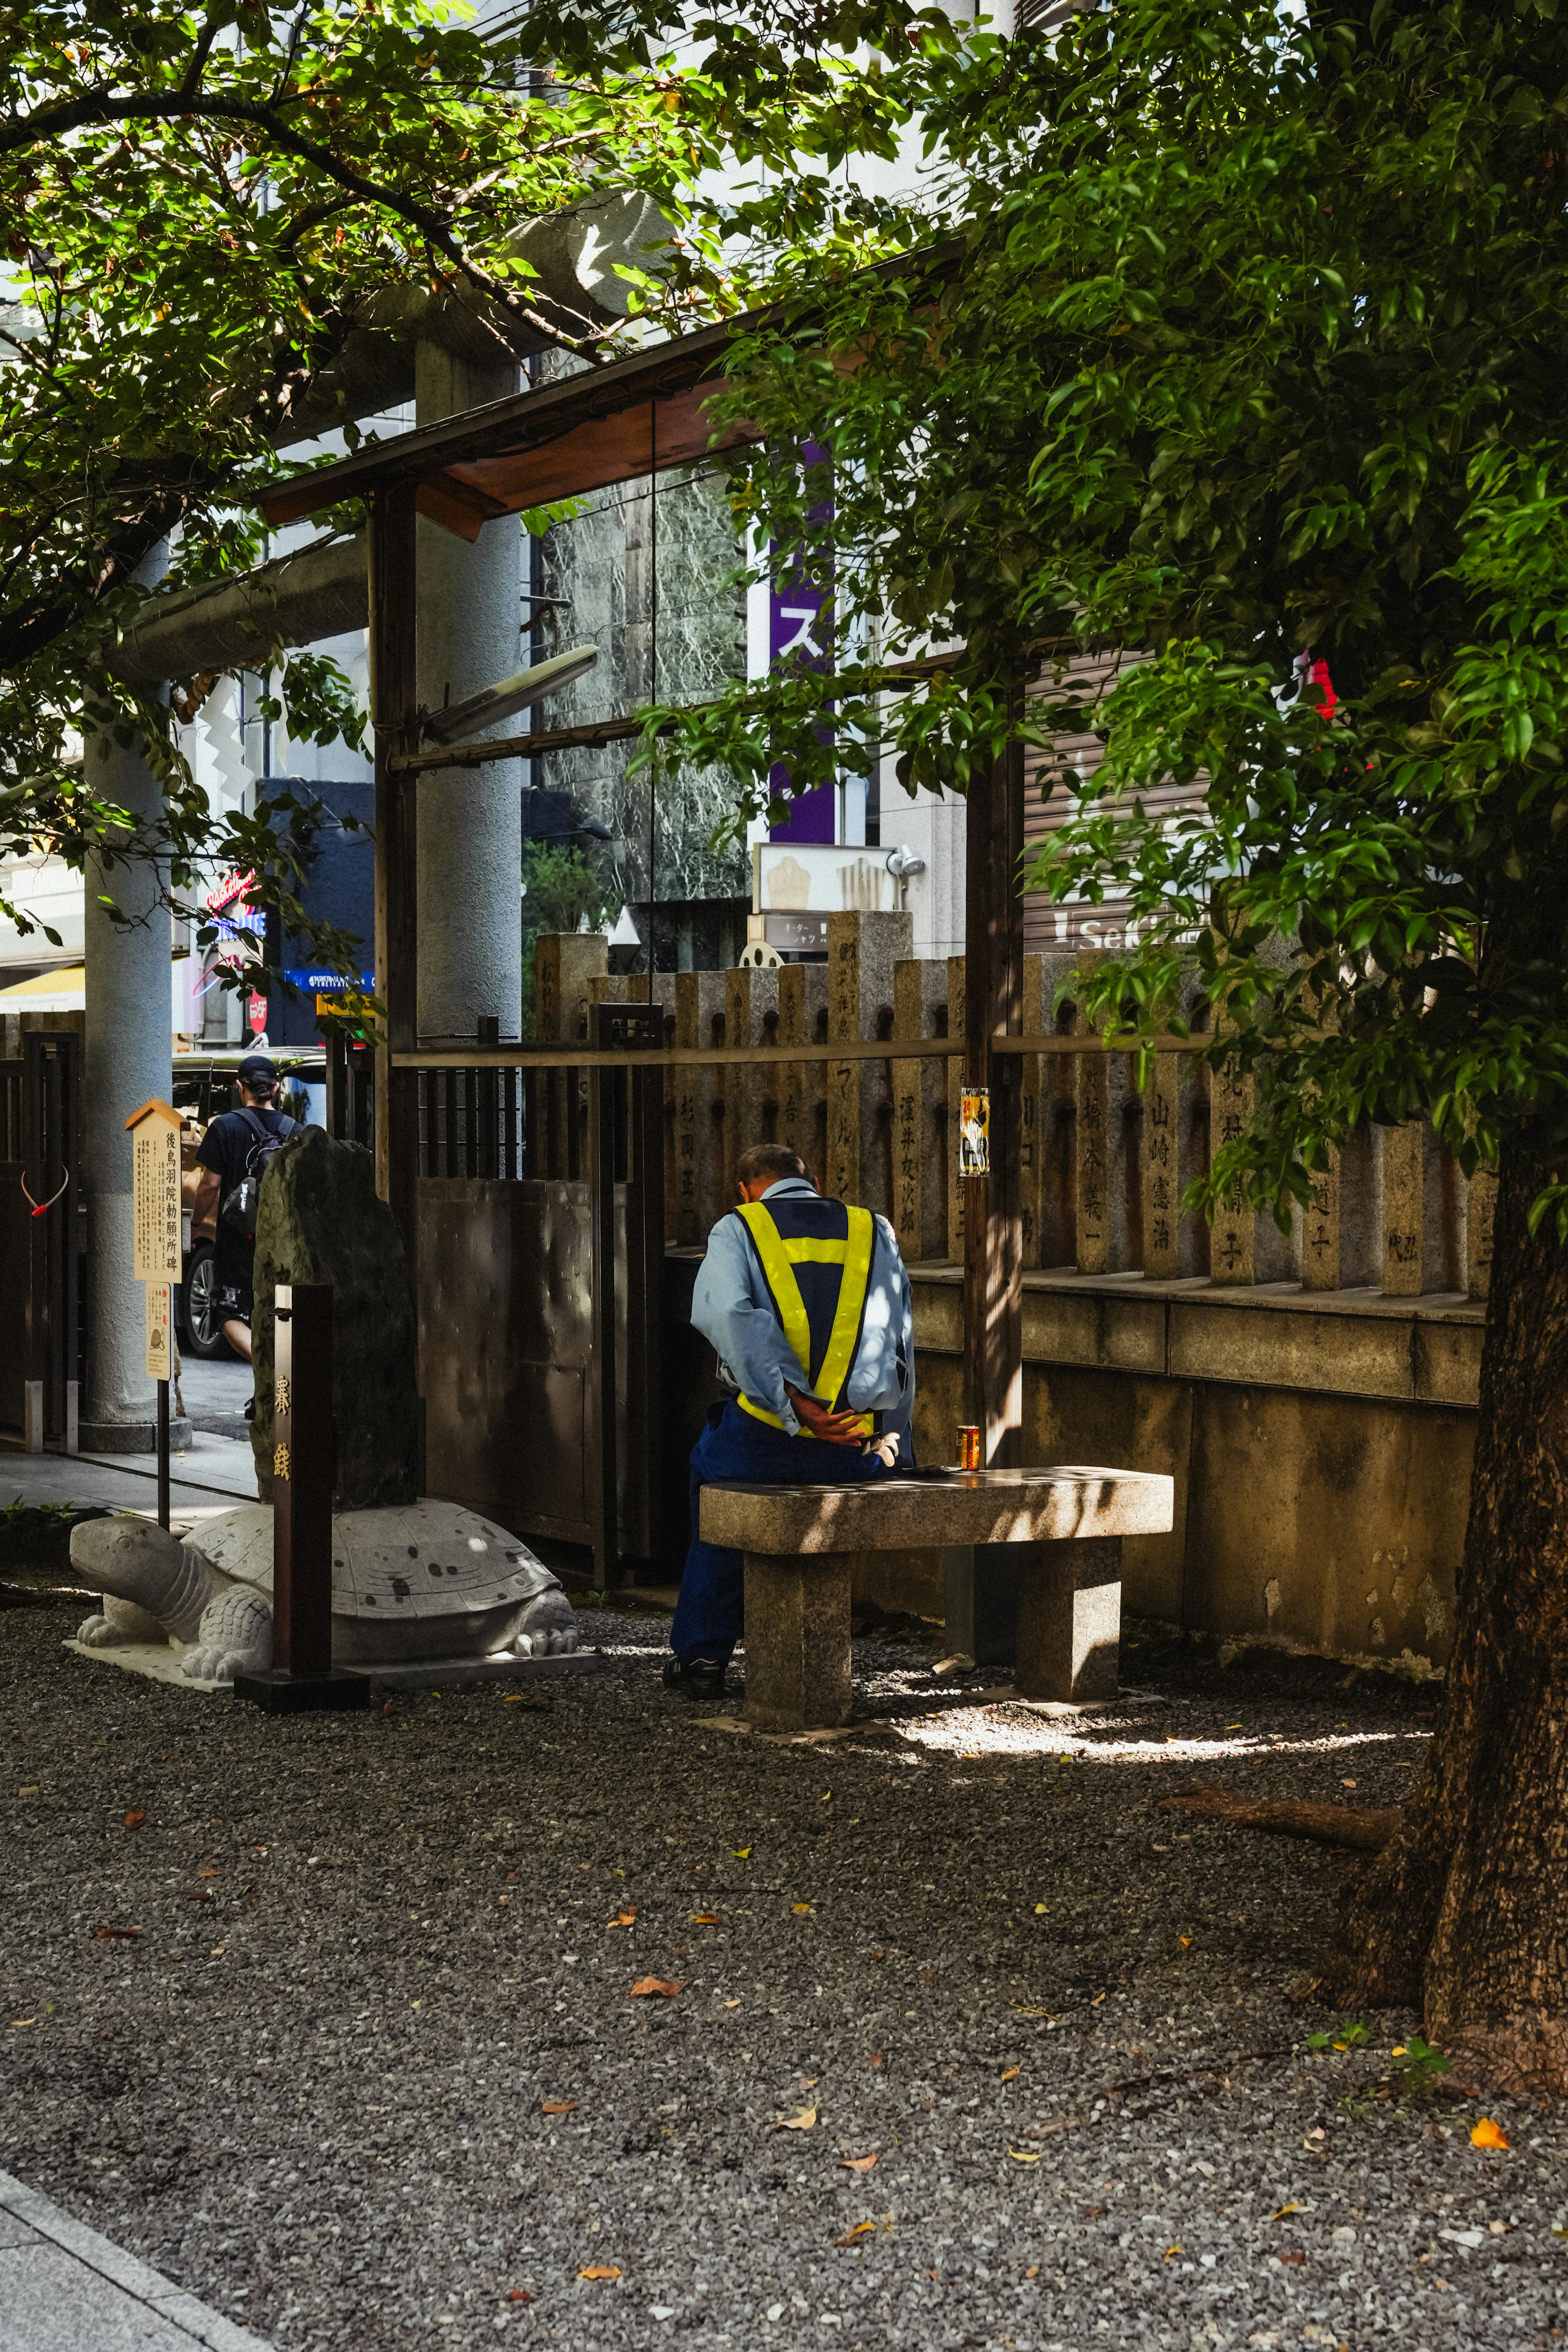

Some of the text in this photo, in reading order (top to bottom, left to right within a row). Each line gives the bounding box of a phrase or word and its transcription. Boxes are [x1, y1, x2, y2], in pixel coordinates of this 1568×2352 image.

[166, 1132, 177, 1273] 後鳥羽院勅願所碑
